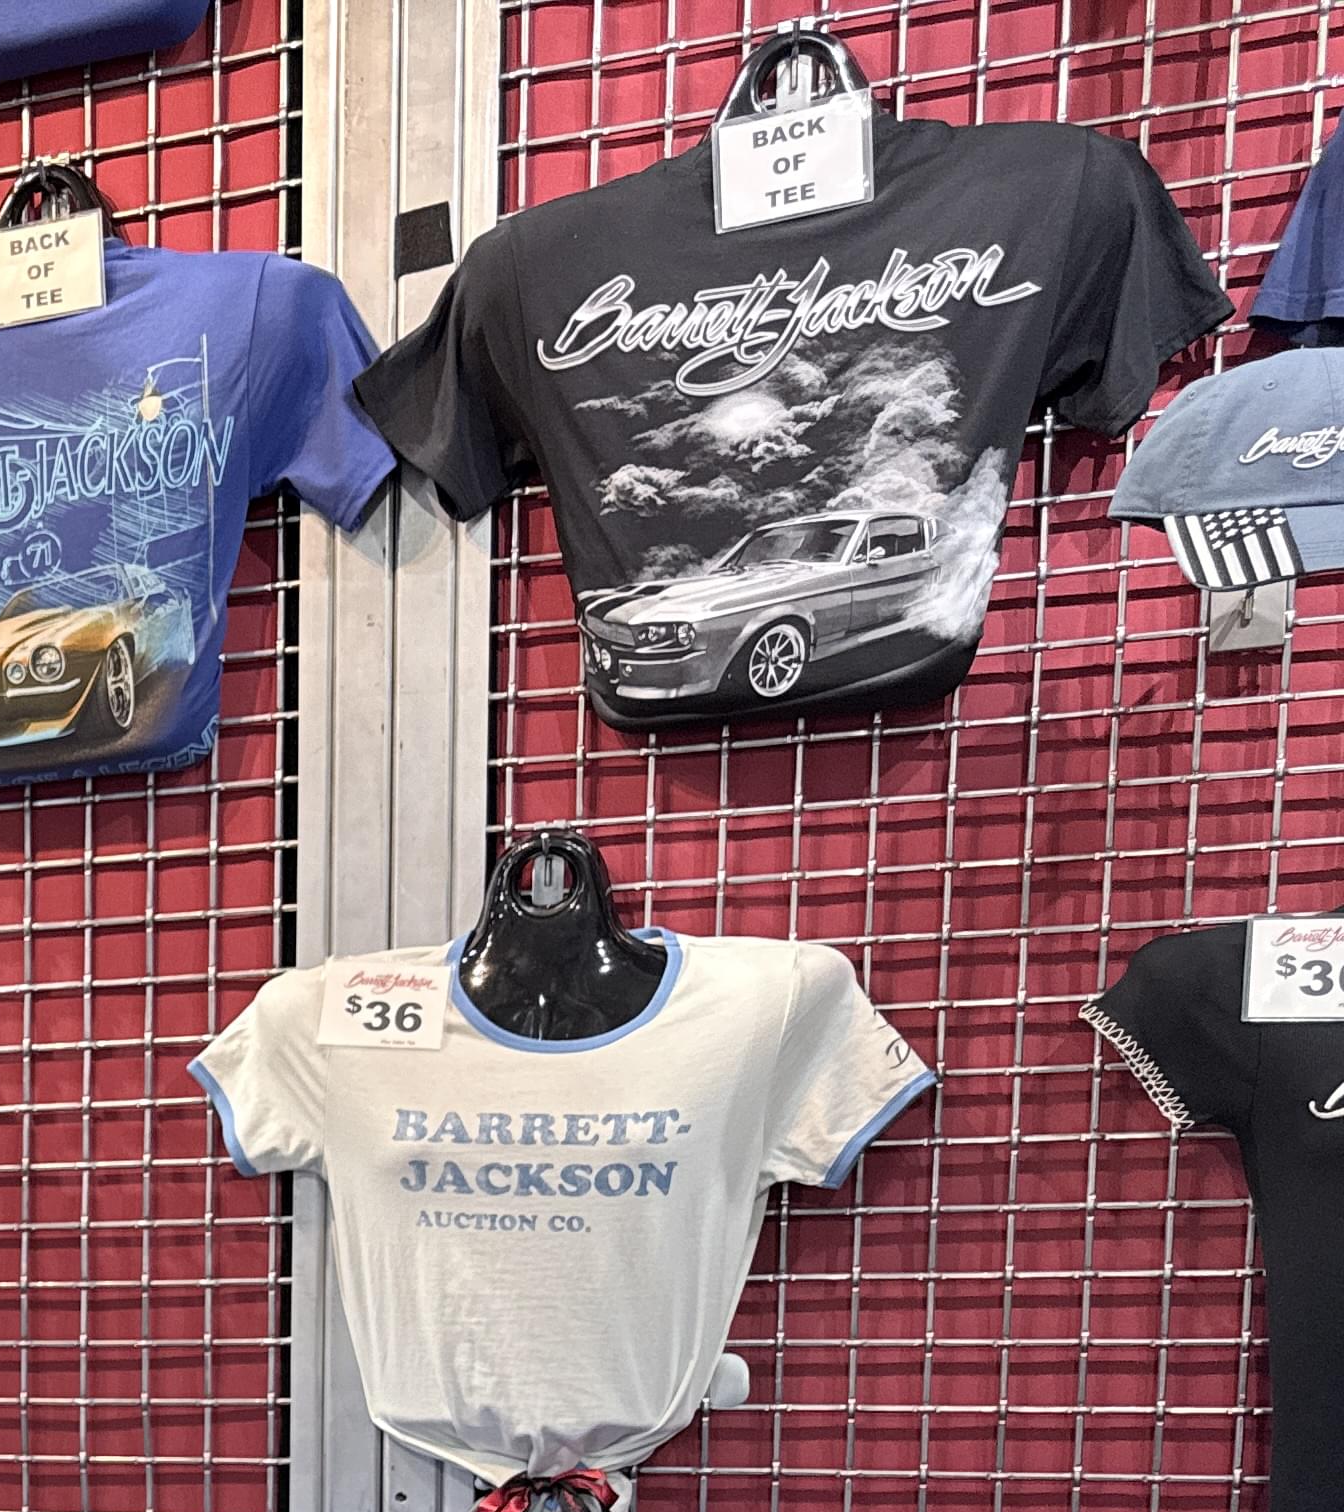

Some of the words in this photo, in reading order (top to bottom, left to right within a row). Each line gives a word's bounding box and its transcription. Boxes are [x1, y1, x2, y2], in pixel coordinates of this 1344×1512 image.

[751, 115, 826, 150] BACK
[772, 151, 807, 175] OF
[766, 182, 816, 209] TEE
[9, 229, 70, 256] BACK
[27, 261, 54, 282] OF
[20, 287, 63, 309] TEE
[538, 244, 1041, 397] Barrett-Jackson
[1239, 426, 1344, 469] Barrett-J
[25, 540, 52, 567] 71
[1275, 953, 1344, 996] $3
[345, 994, 423, 1033] $36
[392, 1108, 692, 1146] BARRETT-
[399, 1159, 678, 1197] JACKSON
[415, 1209, 539, 1232] AUCTION
[547, 1214, 592, 1233] CO.
